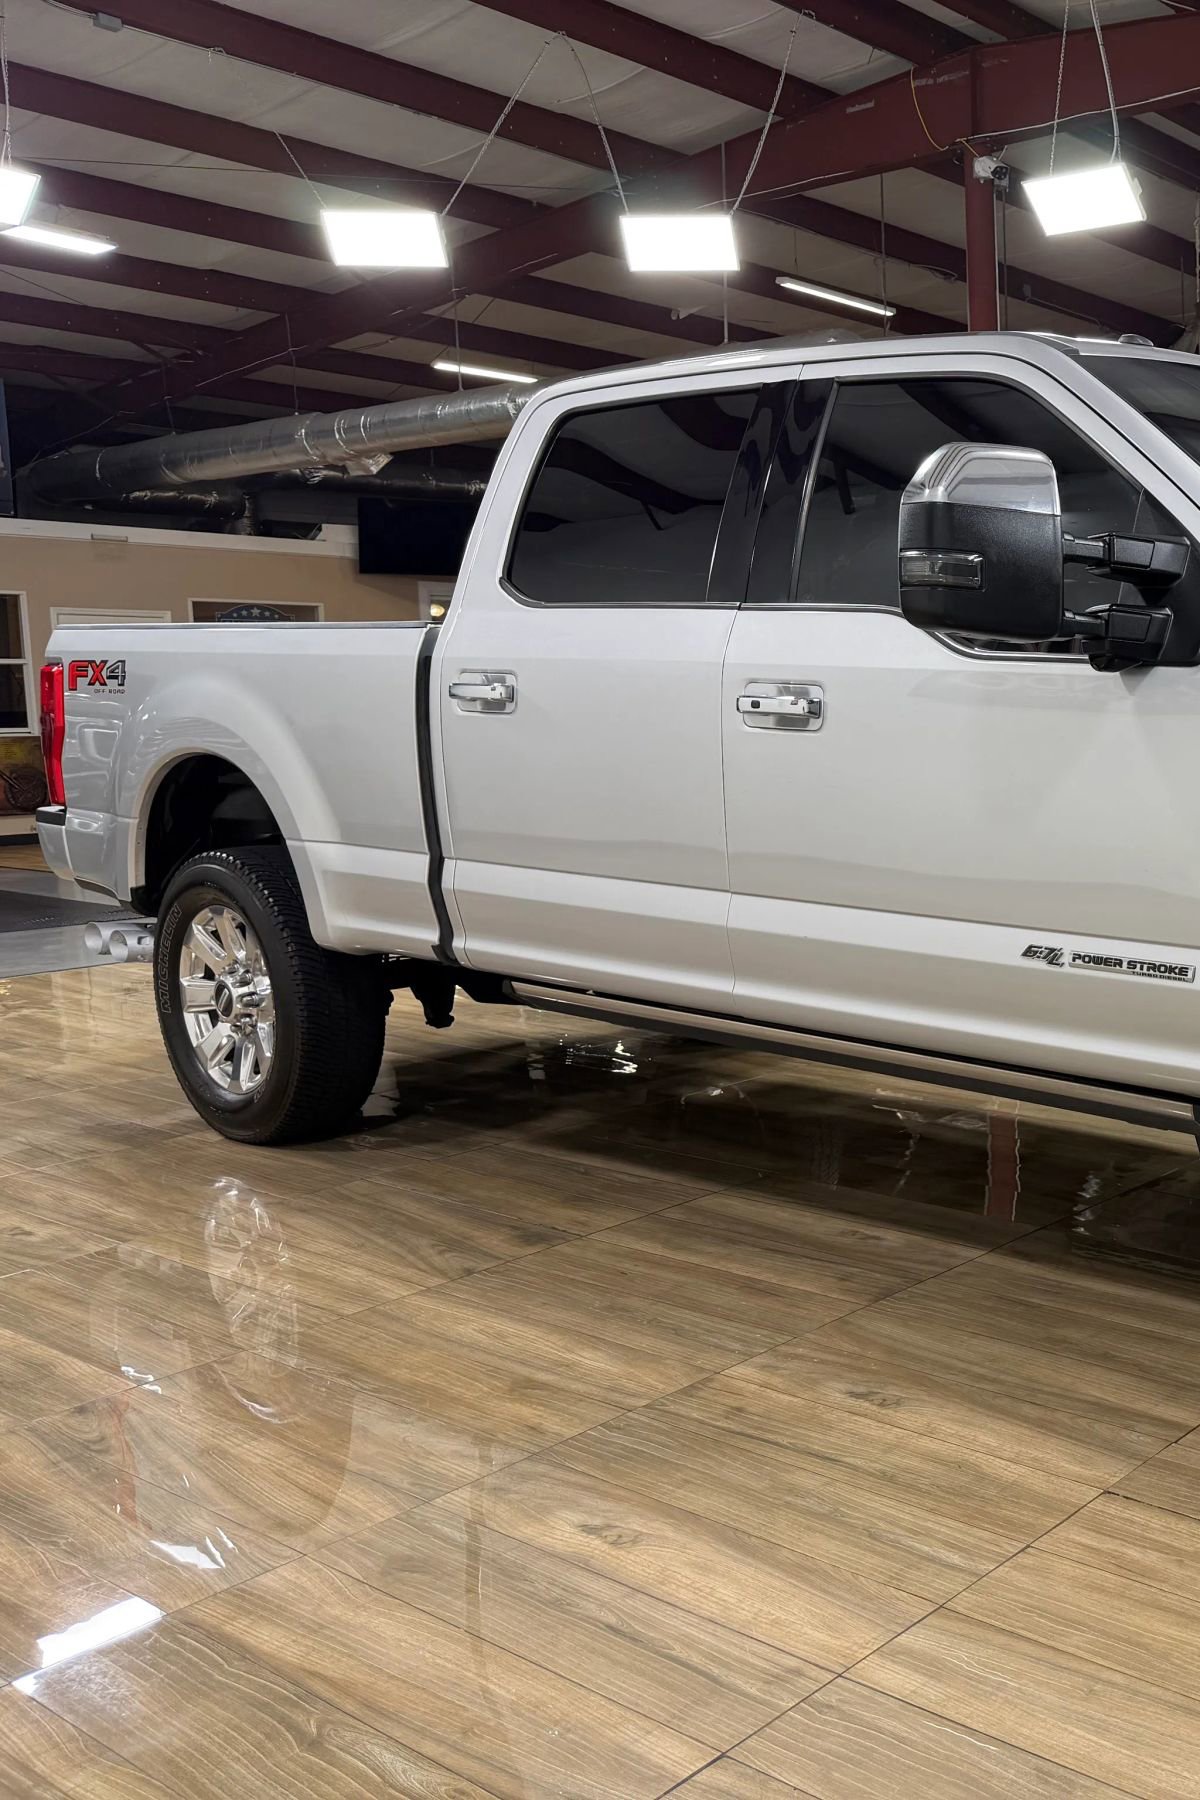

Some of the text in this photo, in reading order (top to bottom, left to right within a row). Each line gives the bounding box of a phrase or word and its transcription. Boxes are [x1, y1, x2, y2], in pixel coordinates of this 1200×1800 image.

[68, 659, 126, 691] FX4
[157, 903, 183, 1014] MICHELIN
[1072, 952, 1190, 977] POWER STROKE
